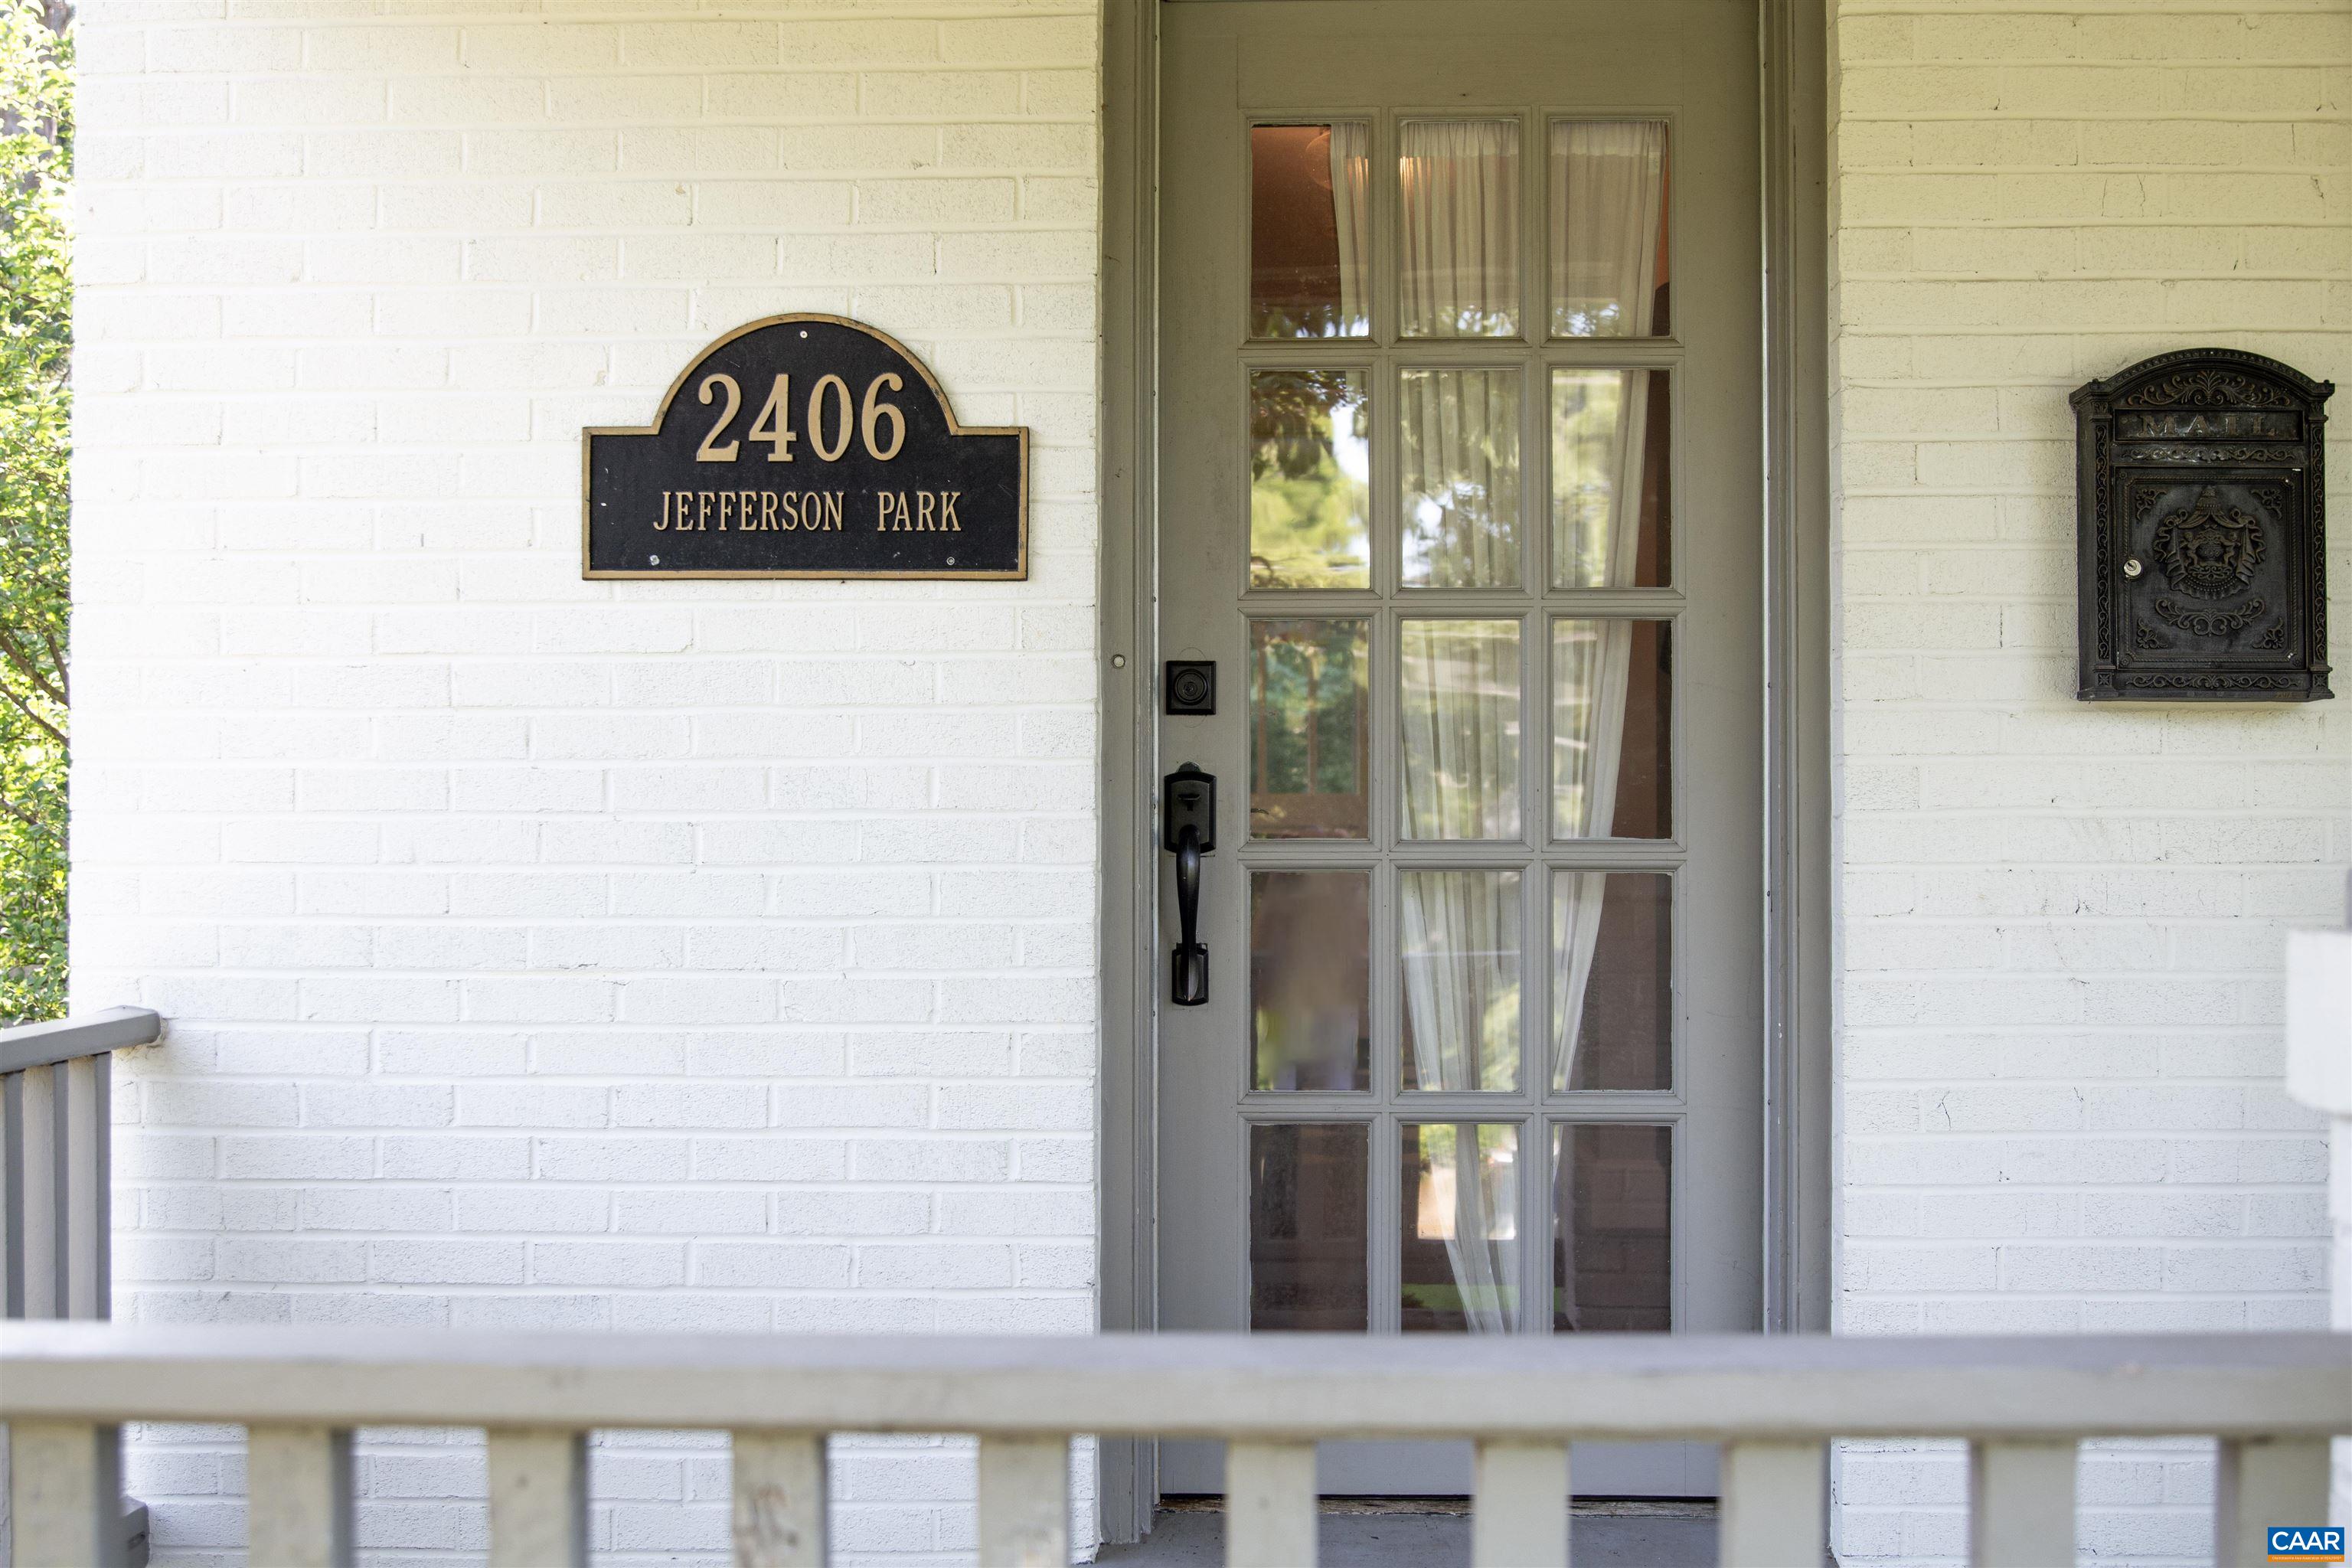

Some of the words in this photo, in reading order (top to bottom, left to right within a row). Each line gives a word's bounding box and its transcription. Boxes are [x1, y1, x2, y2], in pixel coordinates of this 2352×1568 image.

[696, 373, 906, 462] 2406
[2138, 414, 2277, 437] MAIL
[653, 491, 844, 531] JEFFERSON
[877, 491, 962, 531] PARK
